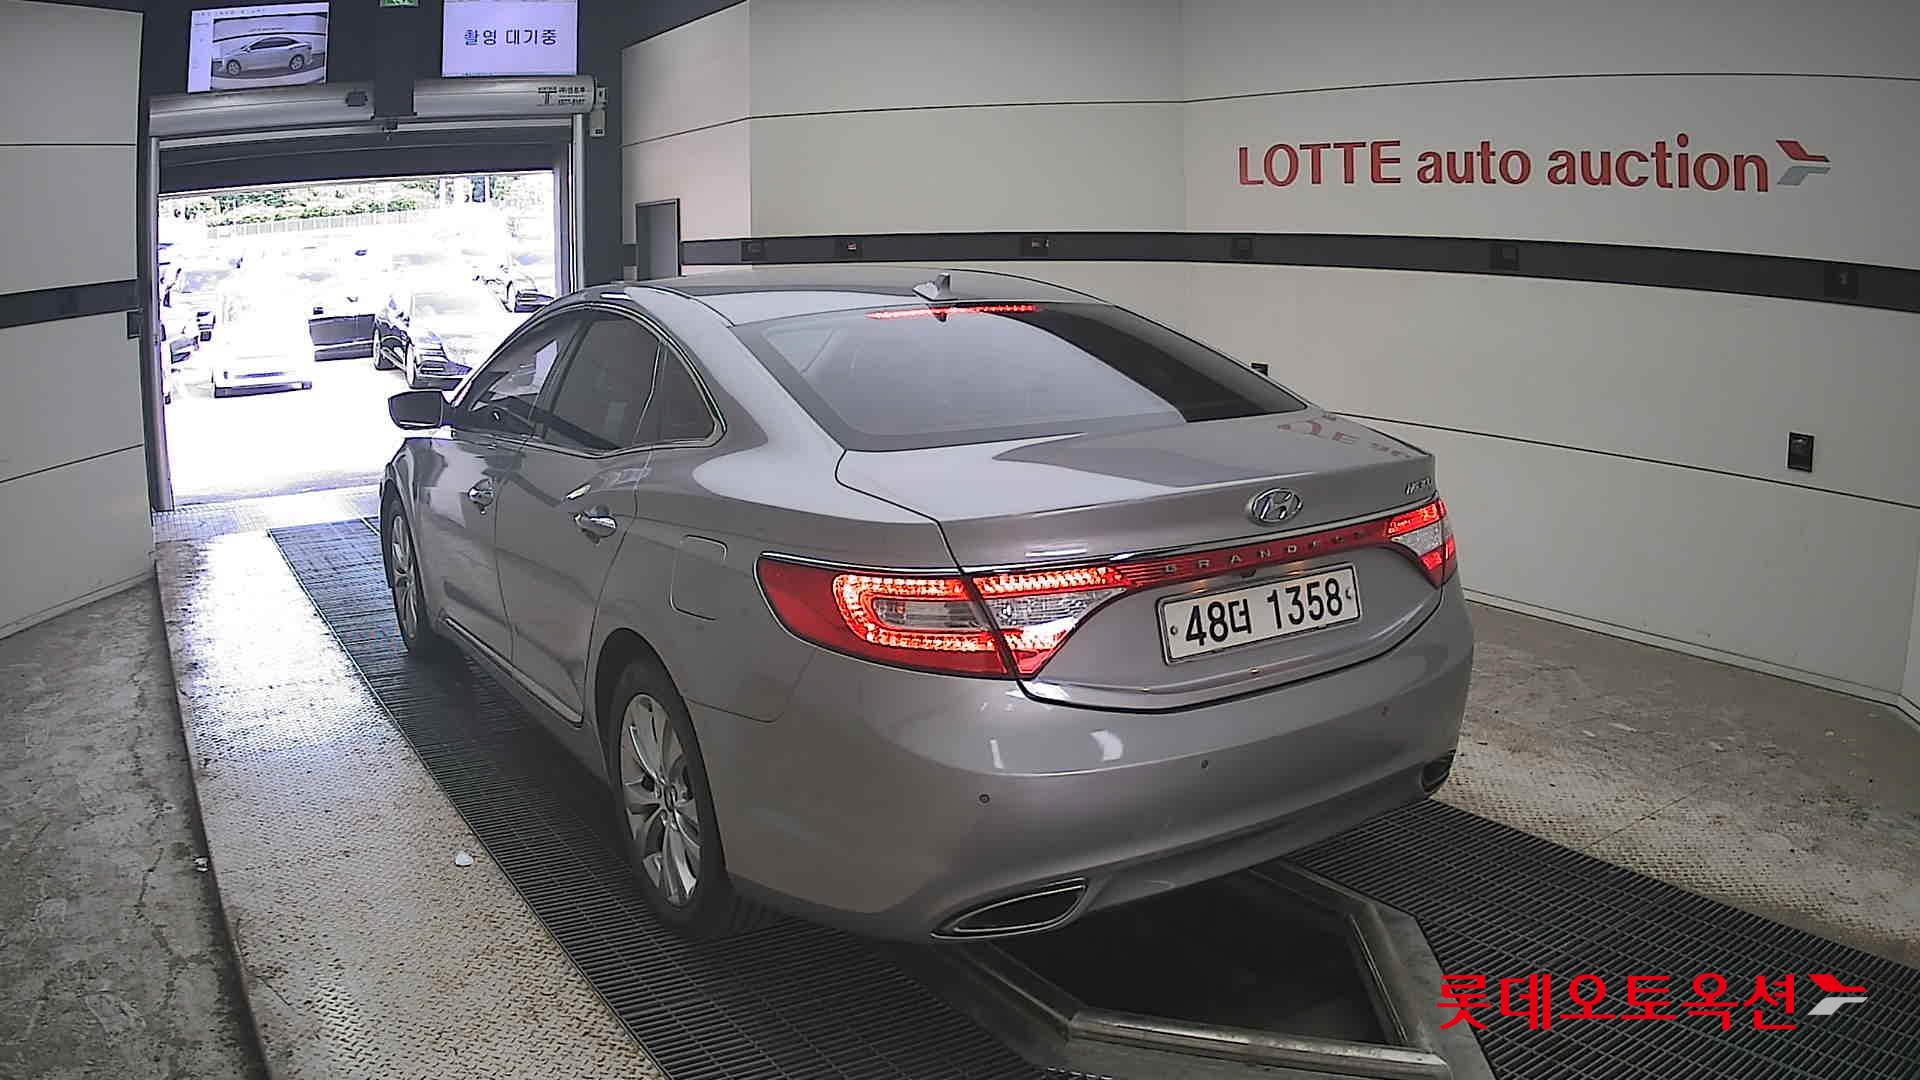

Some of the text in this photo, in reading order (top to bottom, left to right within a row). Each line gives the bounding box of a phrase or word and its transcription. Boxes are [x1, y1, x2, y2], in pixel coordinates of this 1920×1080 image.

[464, 29, 557, 46] 촬영 대기중
[1239, 133, 1769, 192] LOTTE auto auction
[1185, 577, 1343, 646] 48더 1358
